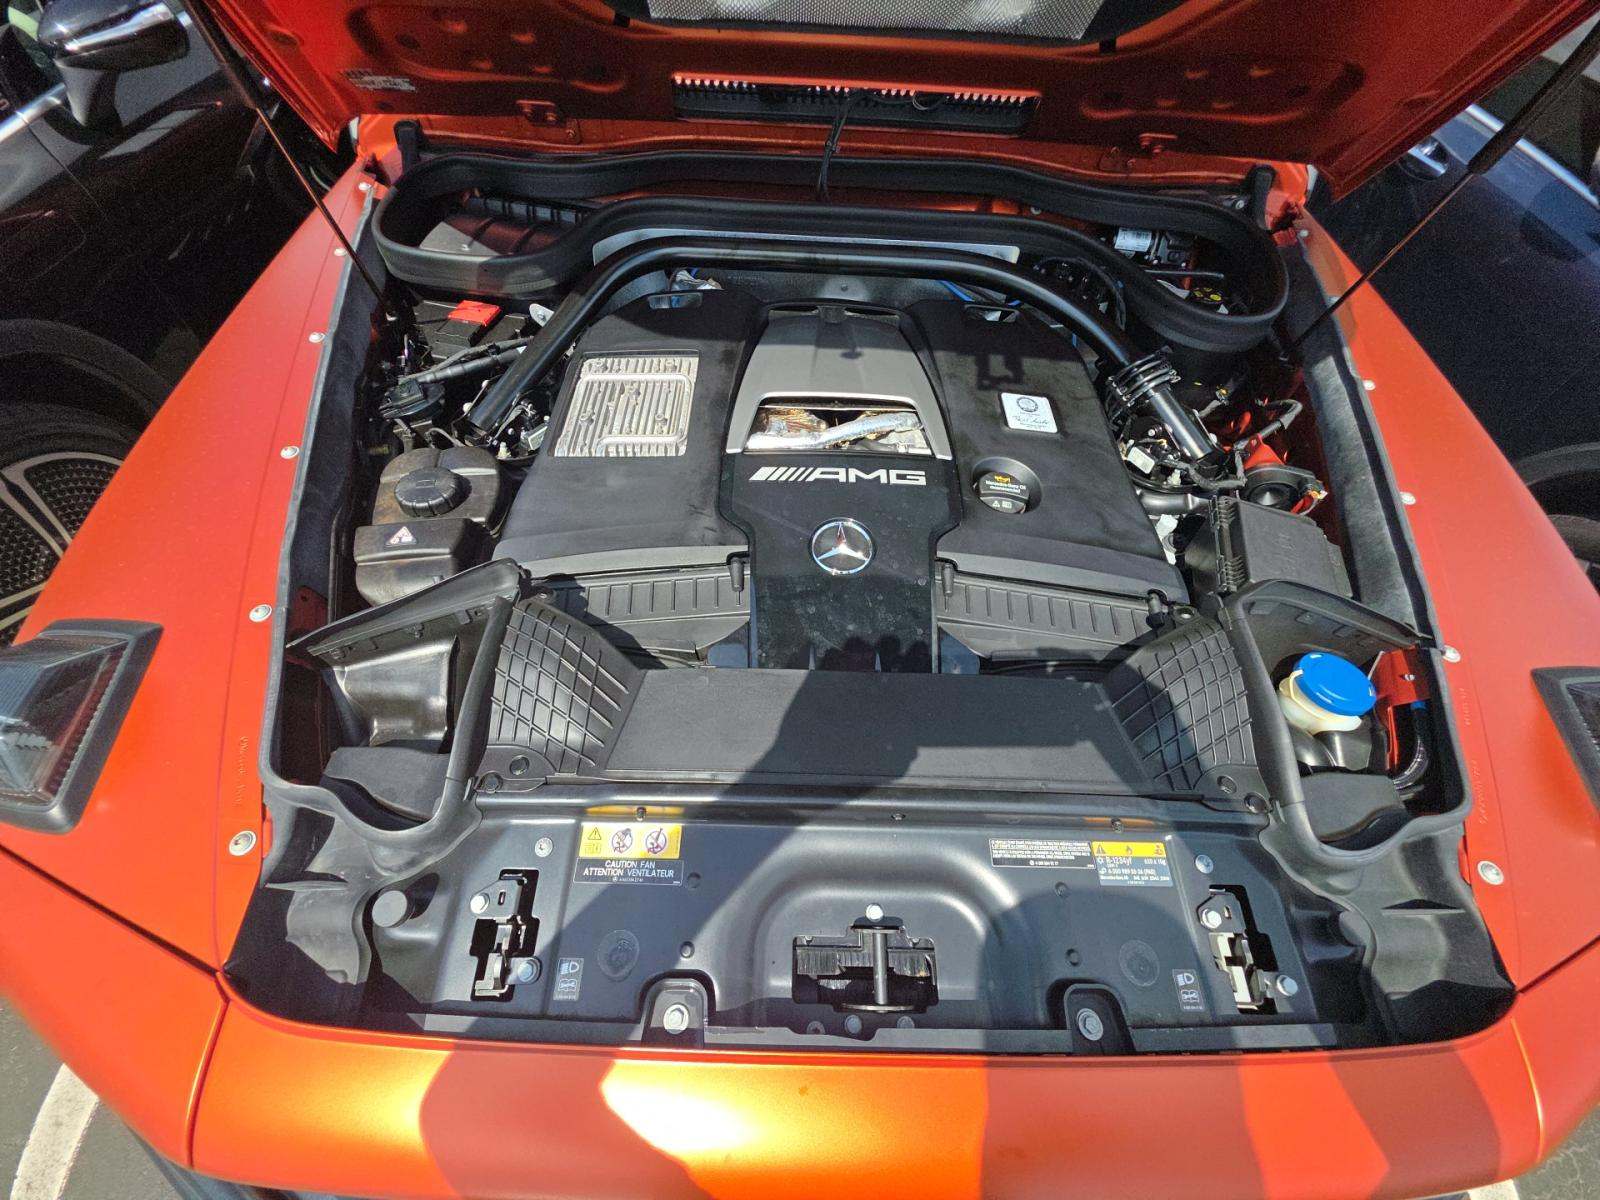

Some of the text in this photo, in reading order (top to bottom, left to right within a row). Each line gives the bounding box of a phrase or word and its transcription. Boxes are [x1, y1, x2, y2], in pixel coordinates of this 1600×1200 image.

[805, 467, 926, 485] AMG
[604, 860, 655, 869] CAUTION FAN
[583, 867, 674, 878] ATTENTION VENTILATEUR
